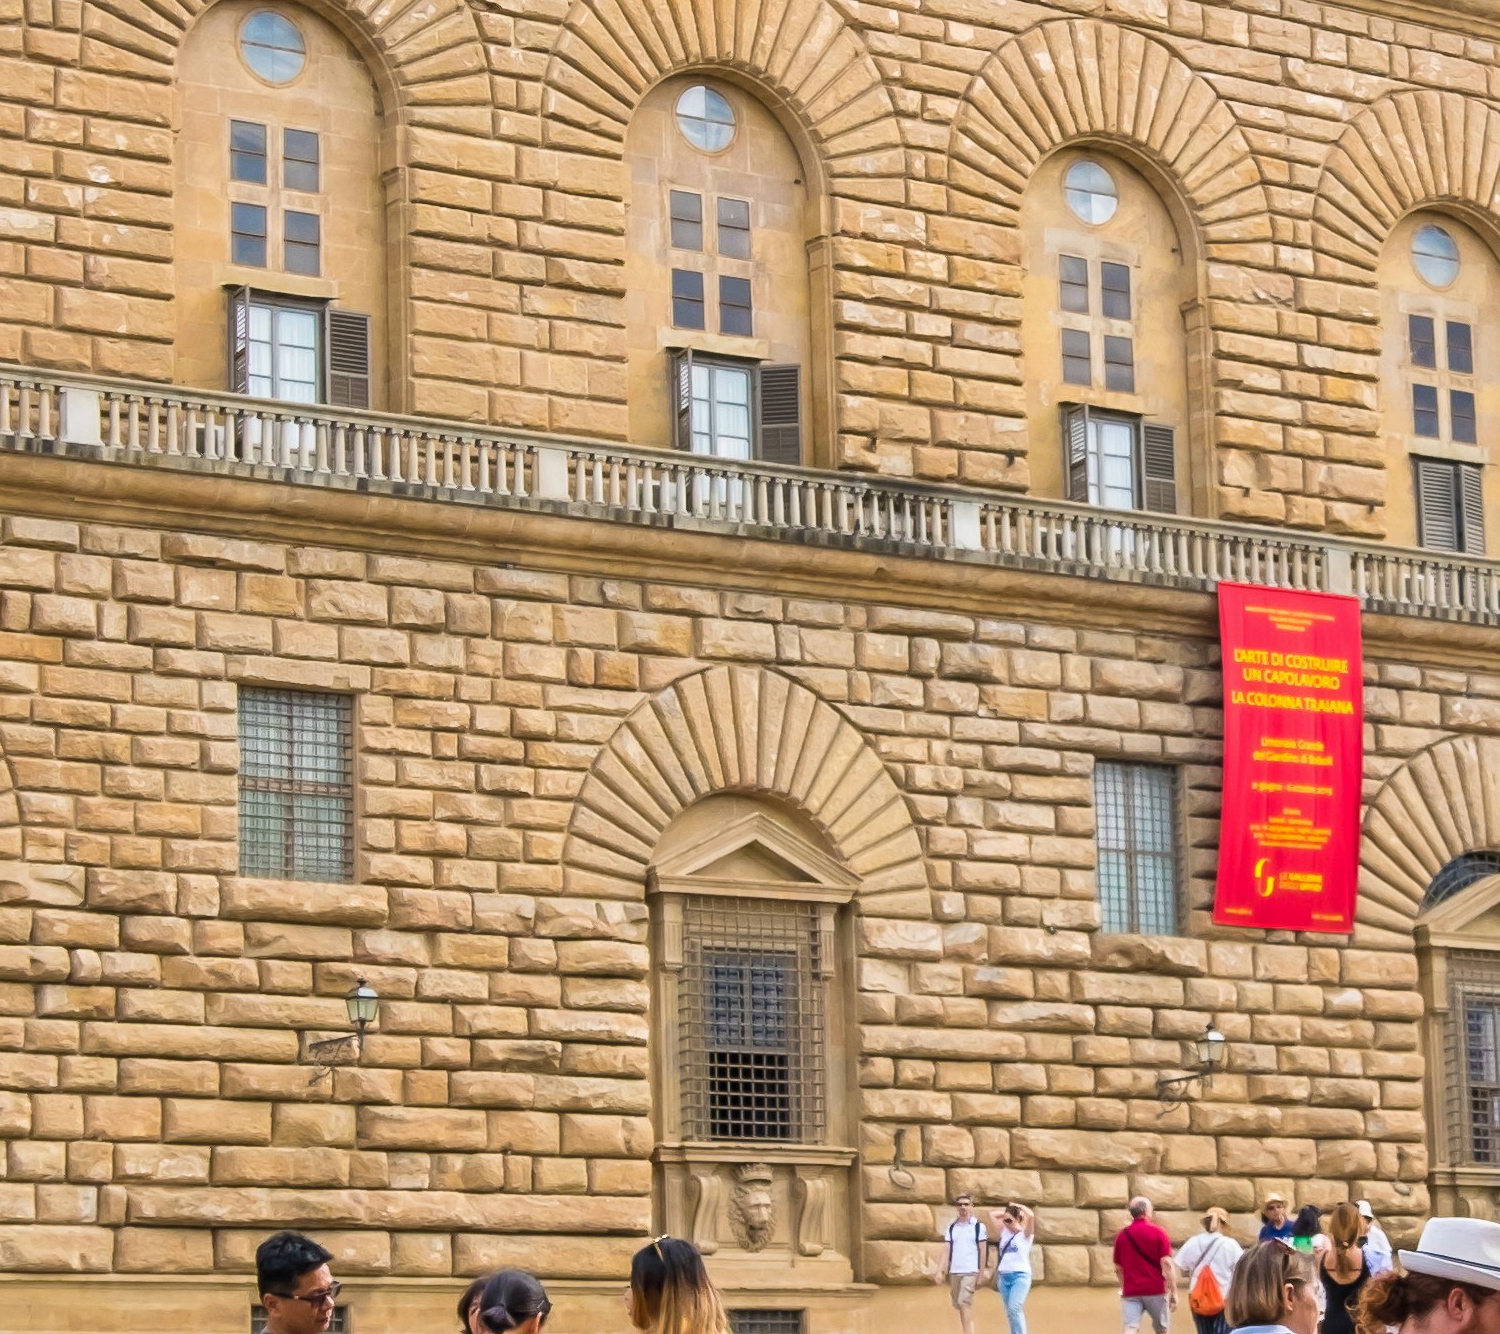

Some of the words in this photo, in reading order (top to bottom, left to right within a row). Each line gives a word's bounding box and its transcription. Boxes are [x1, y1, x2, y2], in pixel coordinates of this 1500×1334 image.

[1271, 652, 1283, 666] DI
[1285, 654, 1348, 674] COSTRUIRE
[1243, 668, 1261, 681] UN
[1264, 670, 1340, 690] CAPOLAVORO
[1231, 690, 1244, 704] LA
[1247, 692, 1303, 709] COLONNA
[1304, 697, 1354, 714] TRAIANA
